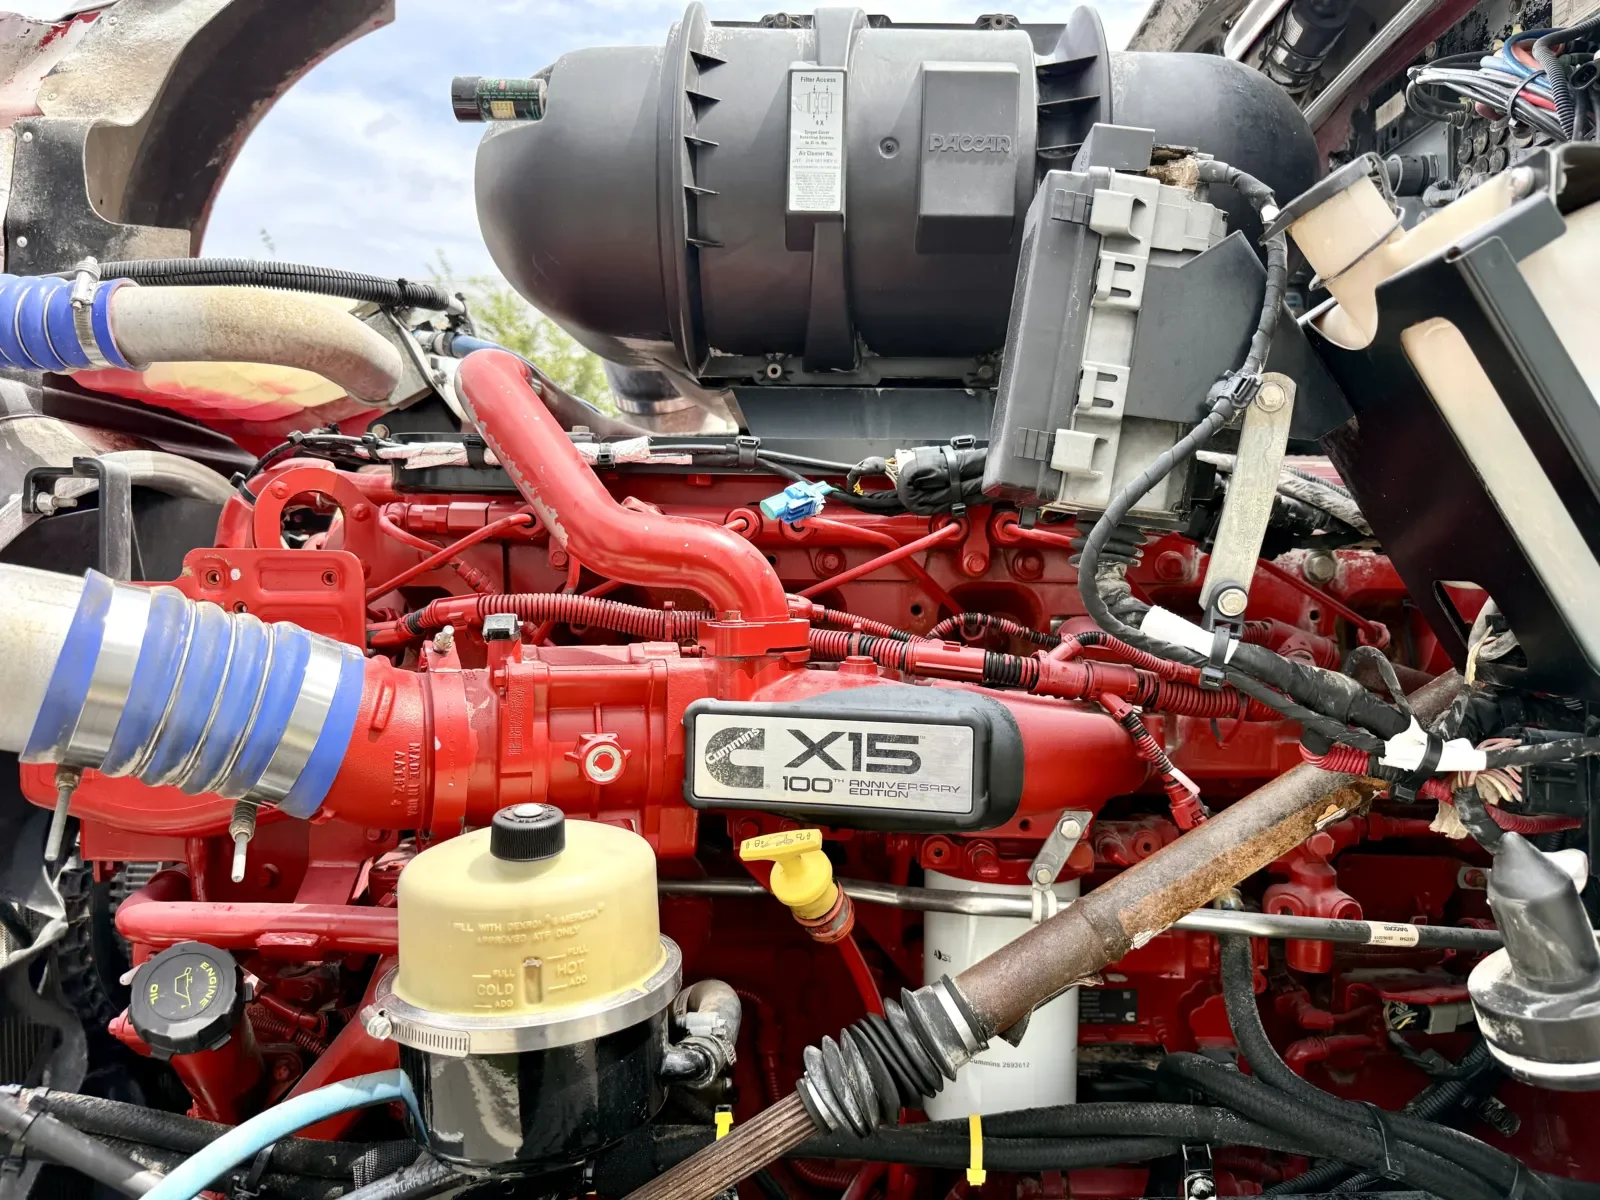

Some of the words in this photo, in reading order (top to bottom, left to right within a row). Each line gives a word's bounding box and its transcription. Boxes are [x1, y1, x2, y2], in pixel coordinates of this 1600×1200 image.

[928, 133, 1011, 153] PACCAR
[705, 727, 761, 764] Cummins
[784, 728, 922, 774] X15
[849, 779, 961, 794] ANNIVERSARY
[849, 787, 909, 799] EDITION
[478, 922, 502, 932] WITH
[532, 930, 552, 942] ATF
[556, 924, 581, 938] ONLY
[567, 944, 589, 955] FULL
[492, 969, 516, 978] FULL
[556, 959, 585, 977] HOT
[199, 961, 218, 1008] ENGINE
[569, 974, 588, 986] ADD
[149, 983, 159, 1006] OIL
[476, 983, 515, 996] COLD
[494, 1000, 514, 1008] ADD
